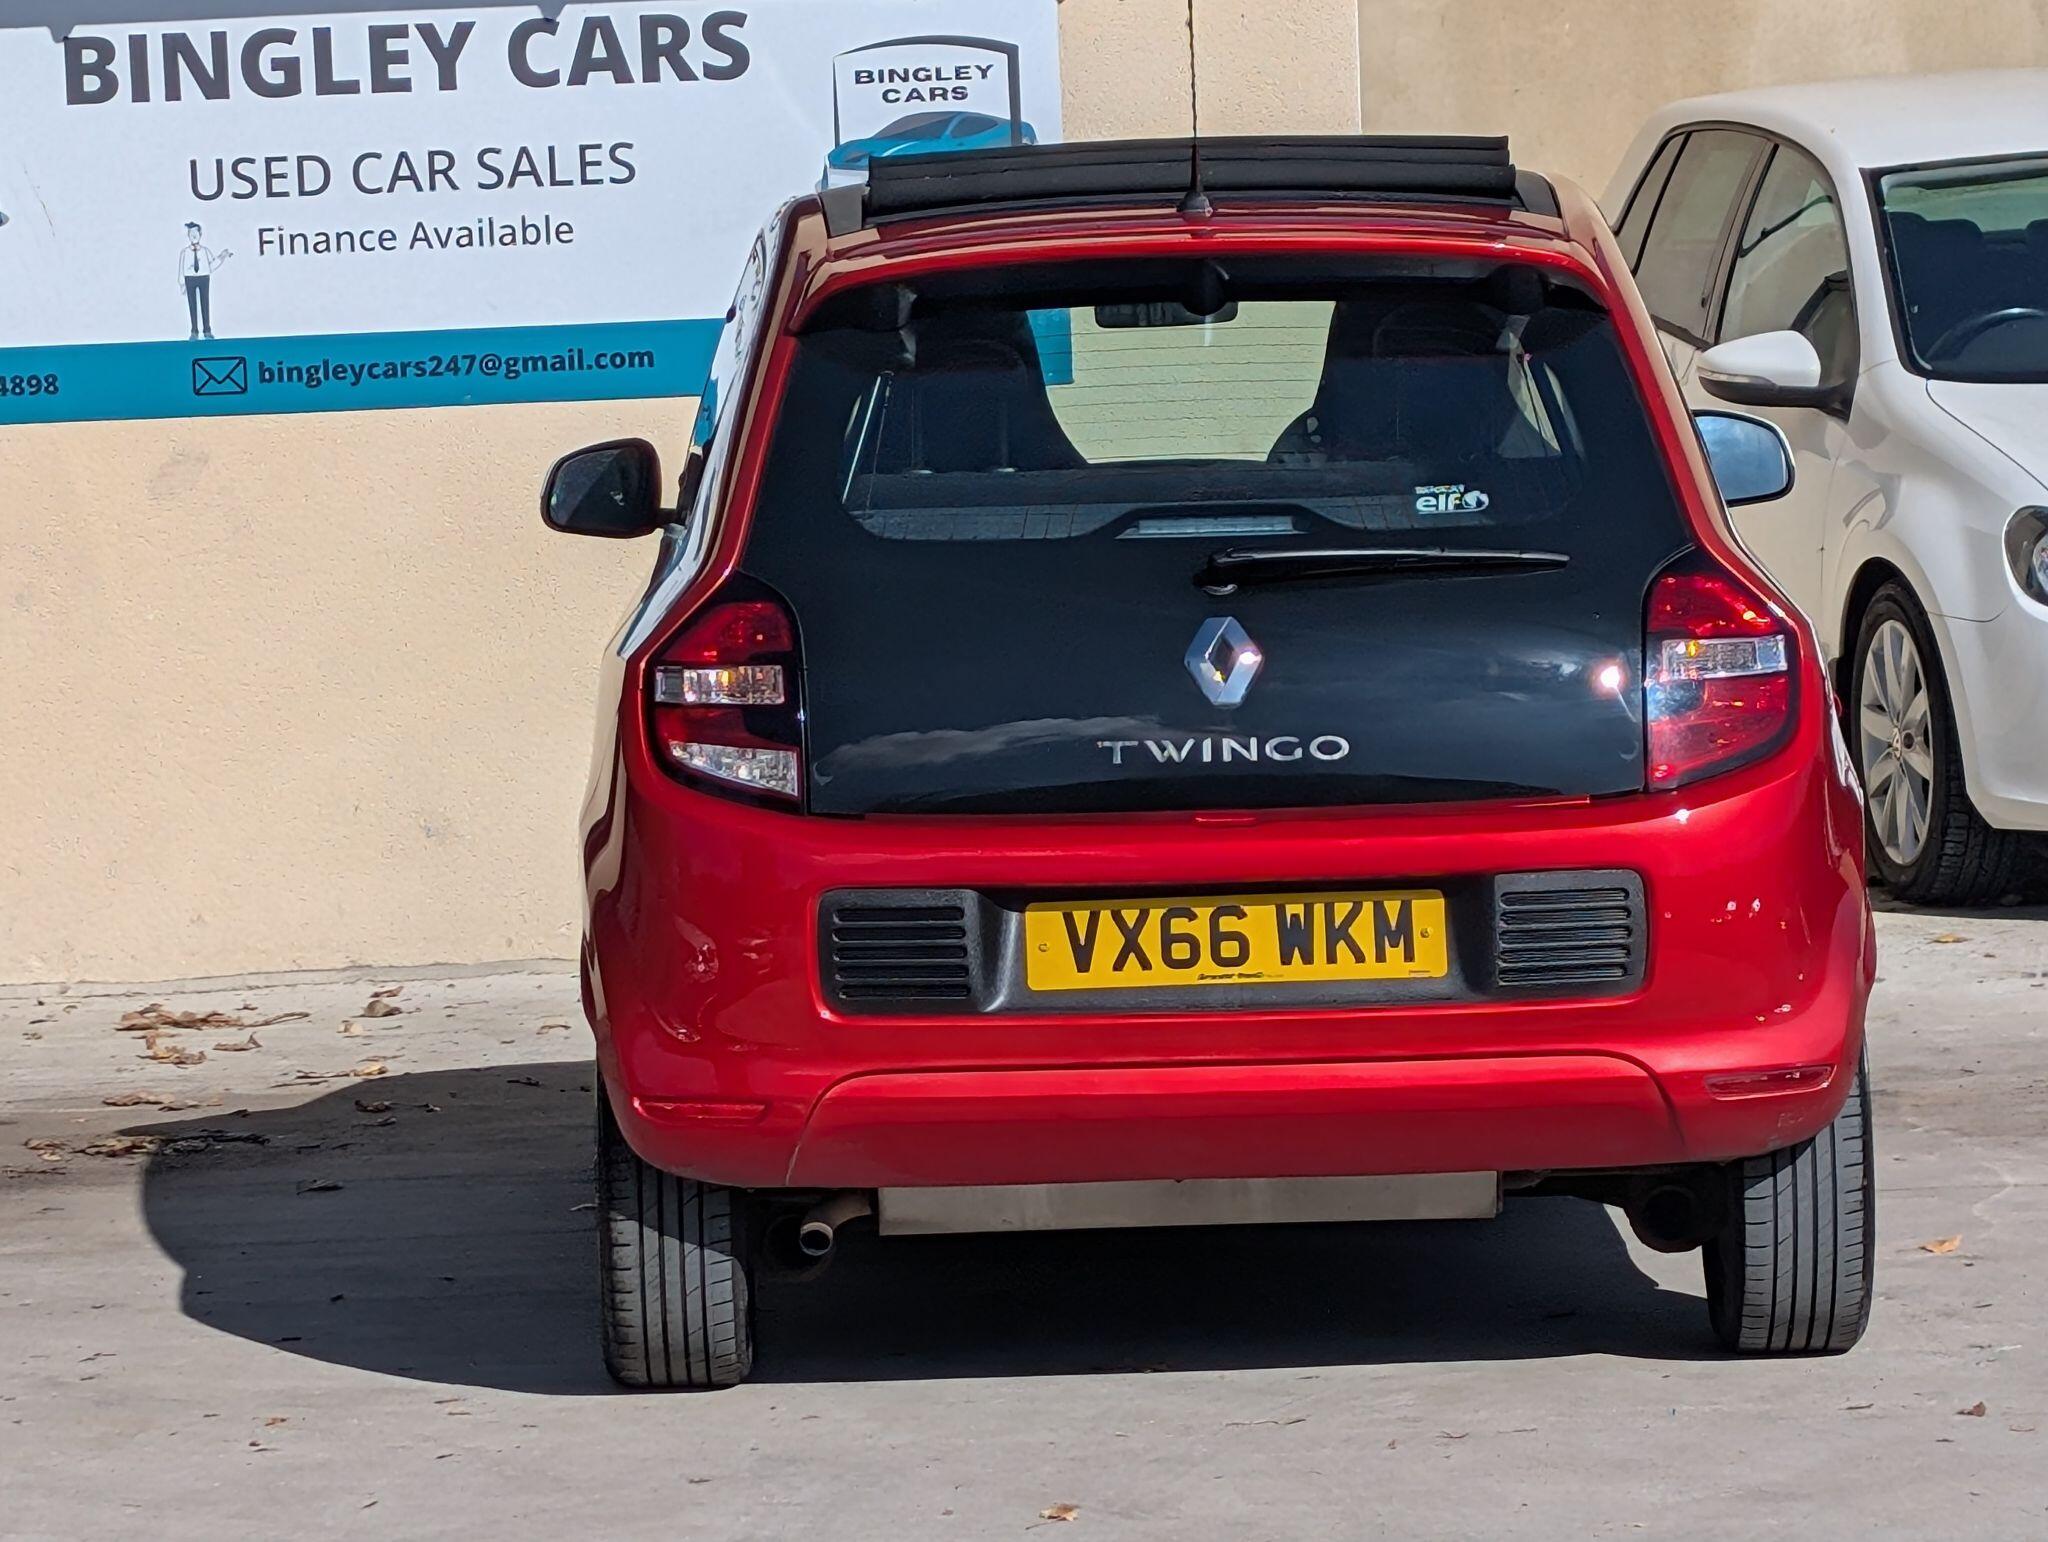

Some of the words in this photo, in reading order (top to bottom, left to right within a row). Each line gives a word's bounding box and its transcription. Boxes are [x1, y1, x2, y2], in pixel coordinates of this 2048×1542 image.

[64, 21, 477, 106] BINGLEY
[507, 11, 751, 89] CARS
[855, 64, 994, 85] BINGLEY
[882, 86, 969, 104] CARS
[189, 155, 331, 201] USED
[352, 150, 460, 195] CAR
[477, 141, 636, 190] SALES
[258, 226, 398, 257] Finance
[409, 215, 574, 251] Available
[258, 346, 655, 388] bingleycars247@gmail.com
[1416, 493, 1462, 512] elf
[1097, 735, 1350, 764] TWINGO
[1061, 904, 1251, 974] VX66
[1274, 899, 1416, 966] WKM
